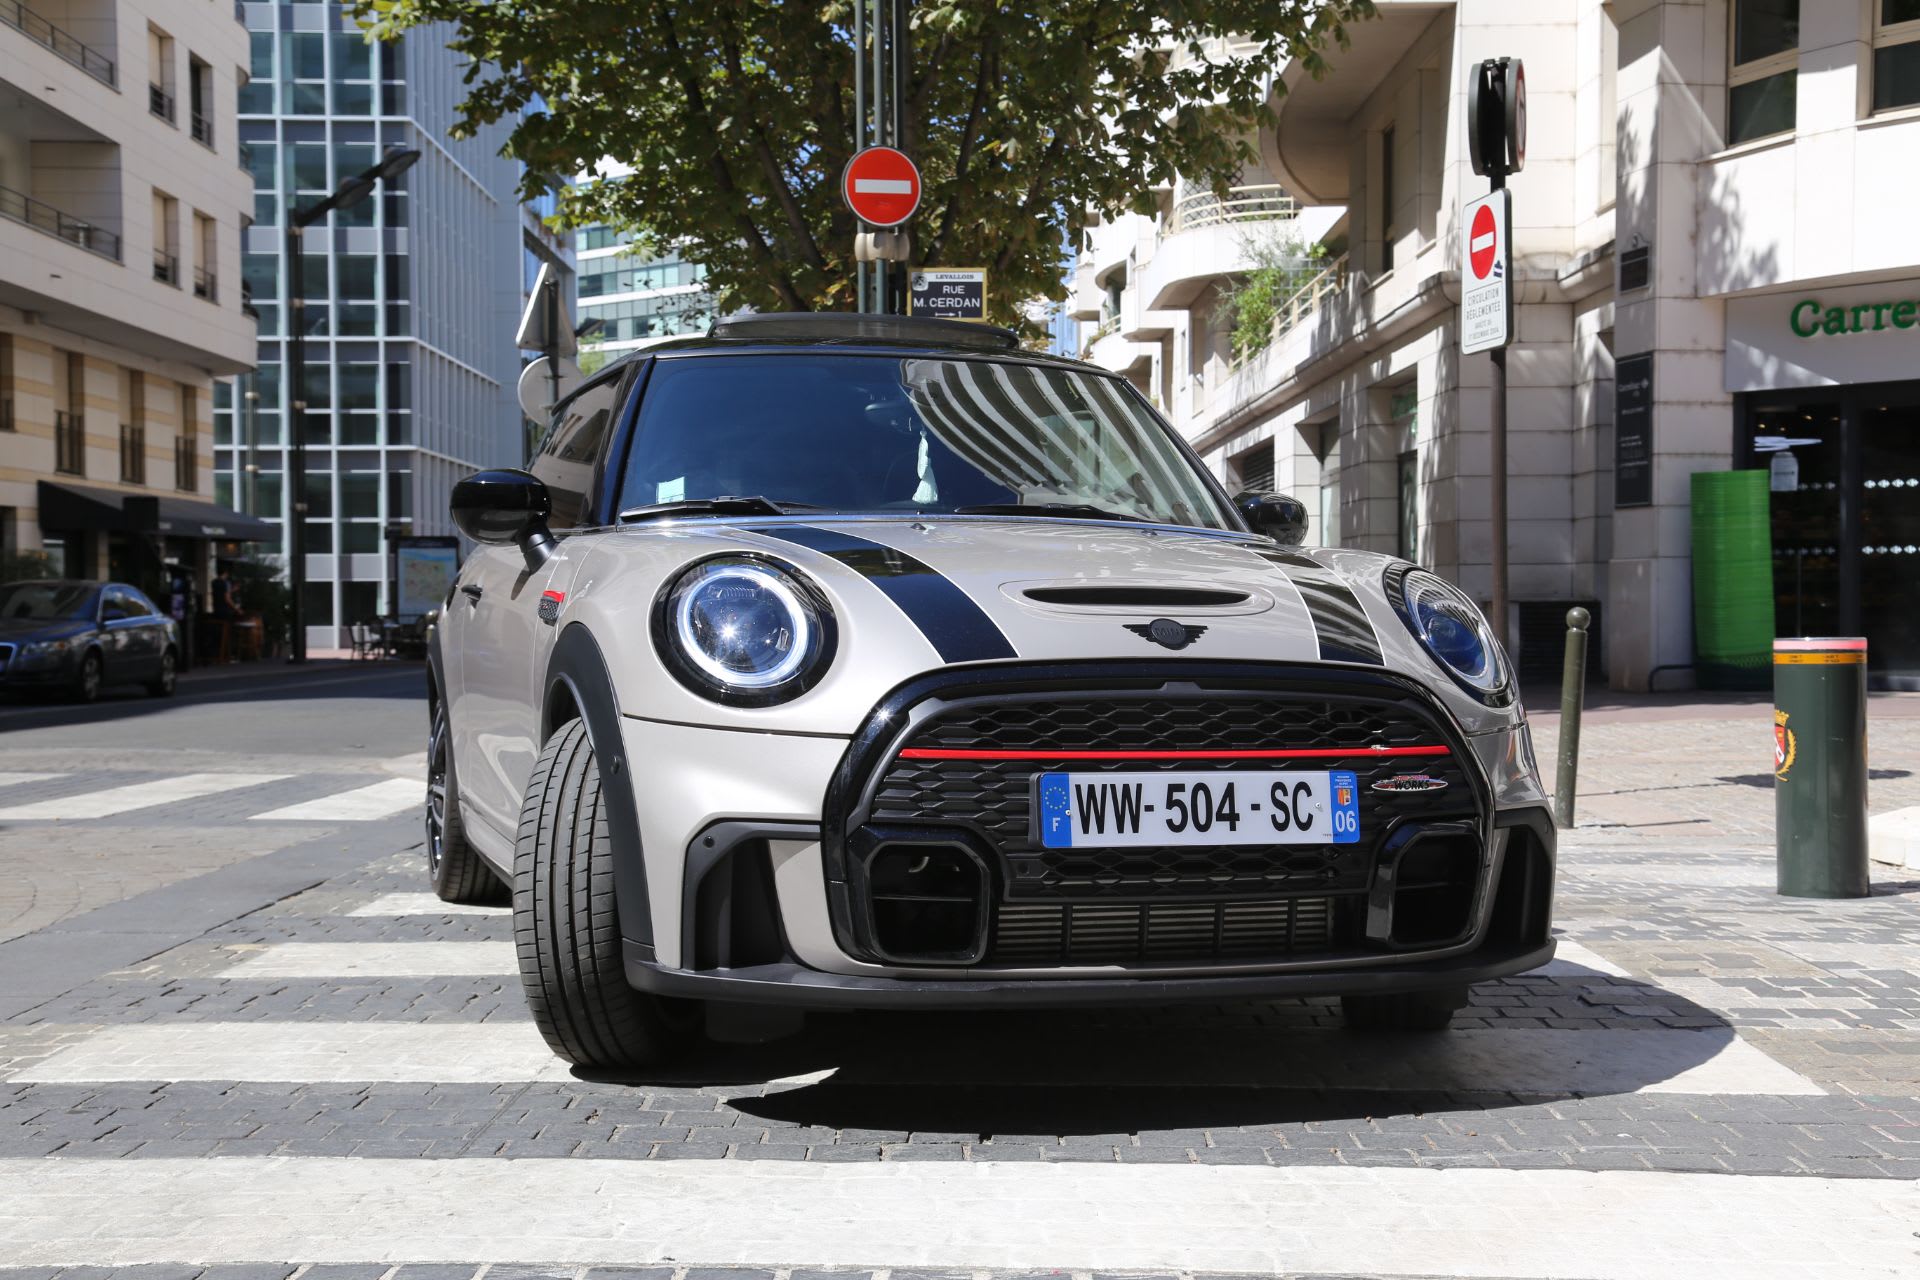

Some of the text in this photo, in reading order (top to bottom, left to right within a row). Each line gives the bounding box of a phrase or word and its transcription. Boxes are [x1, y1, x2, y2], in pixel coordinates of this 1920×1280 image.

[943, 285, 965, 294] RUE
[1467, 287, 1499, 306] CIRCULATION
[913, 297, 980, 308] M. CERDAN
[1790, 300, 1920, 338] Carre
[1394, 779, 1430, 790] WORKS
[1052, 817, 1061, 832] F
[1335, 810, 1357, 833] 06
